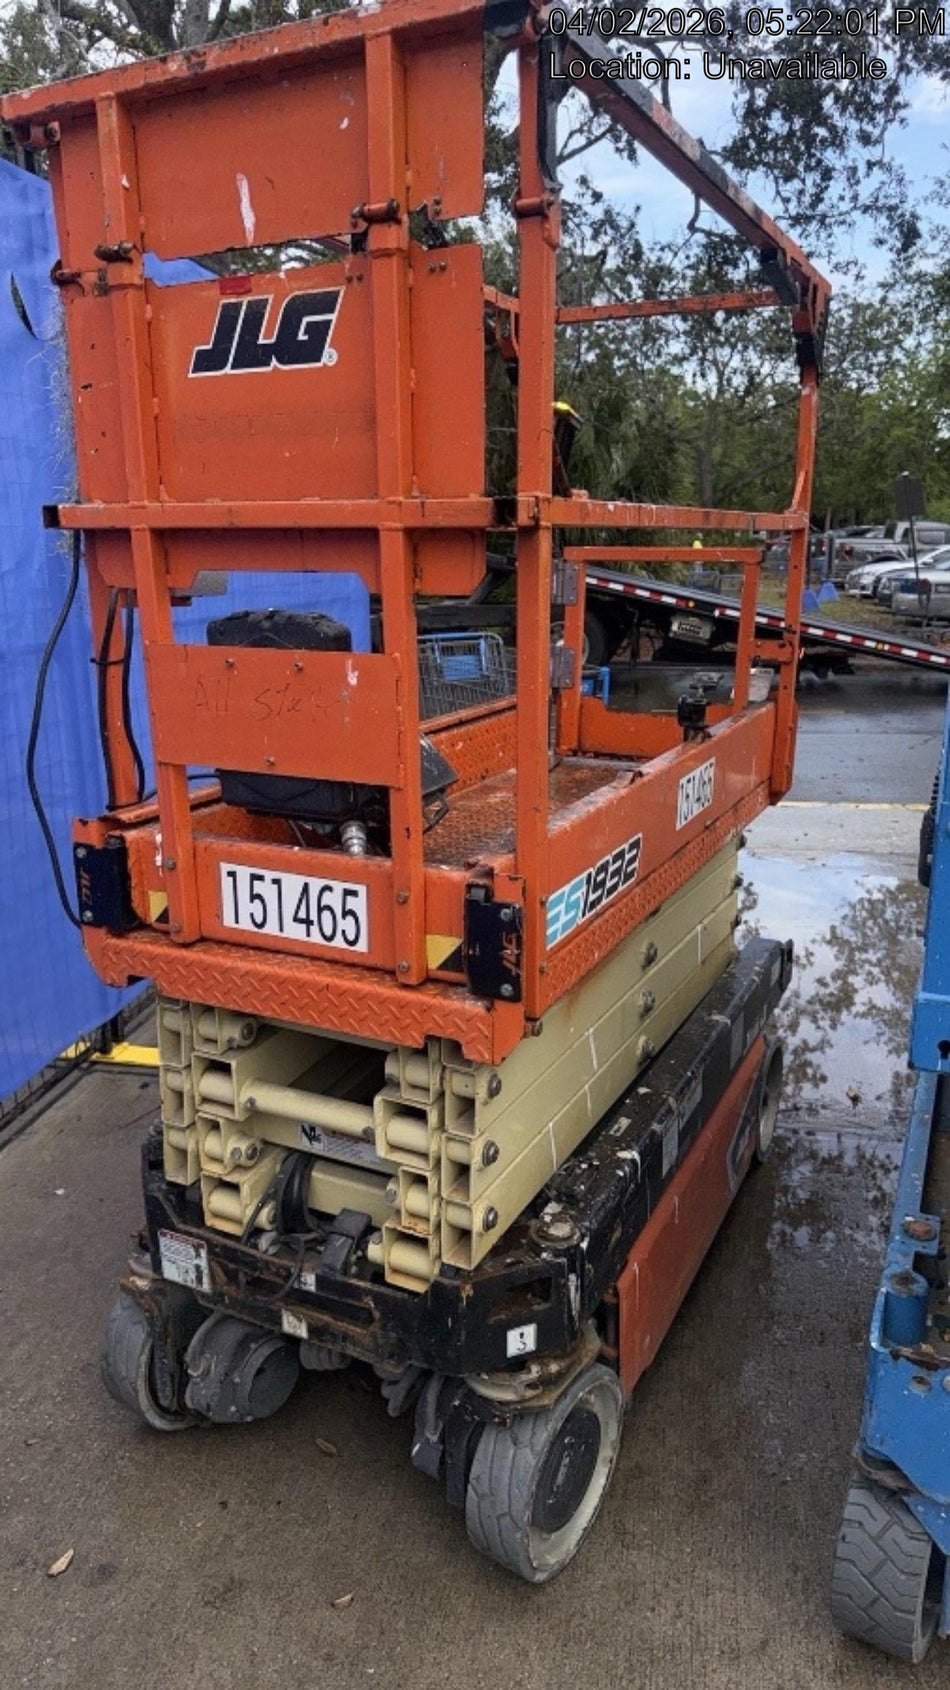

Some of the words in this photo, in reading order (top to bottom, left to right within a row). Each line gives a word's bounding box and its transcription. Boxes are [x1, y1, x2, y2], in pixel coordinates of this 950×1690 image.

[188, 285, 345, 378] JLG
[226, 870, 361, 947] 151465
[546, 834, 641, 948] ES1932
